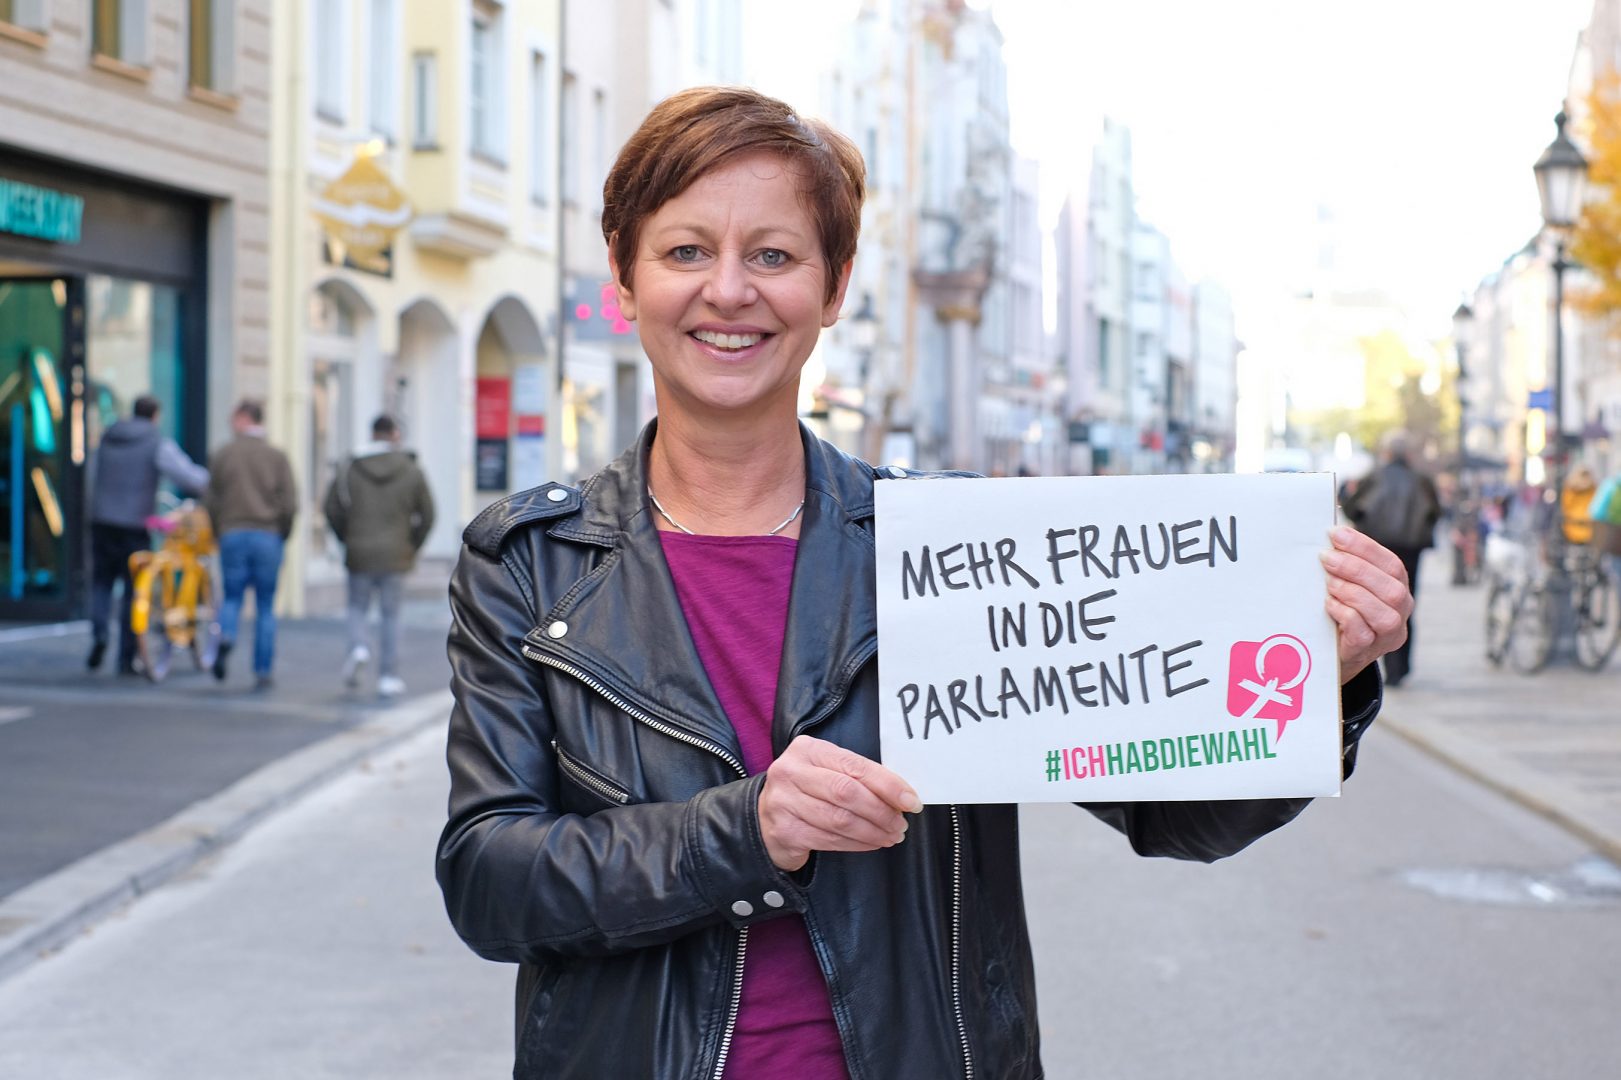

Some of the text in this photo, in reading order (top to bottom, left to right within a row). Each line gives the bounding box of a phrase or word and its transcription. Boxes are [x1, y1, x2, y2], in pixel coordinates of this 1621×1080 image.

[902, 516, 1238, 600] MEHR FRAUEN
[988, 589, 1117, 652] IN DIE
[897, 640, 1209, 741] PARLAMENTE
[1046, 727, 1277, 782] #ICHHABDIEWAHL
